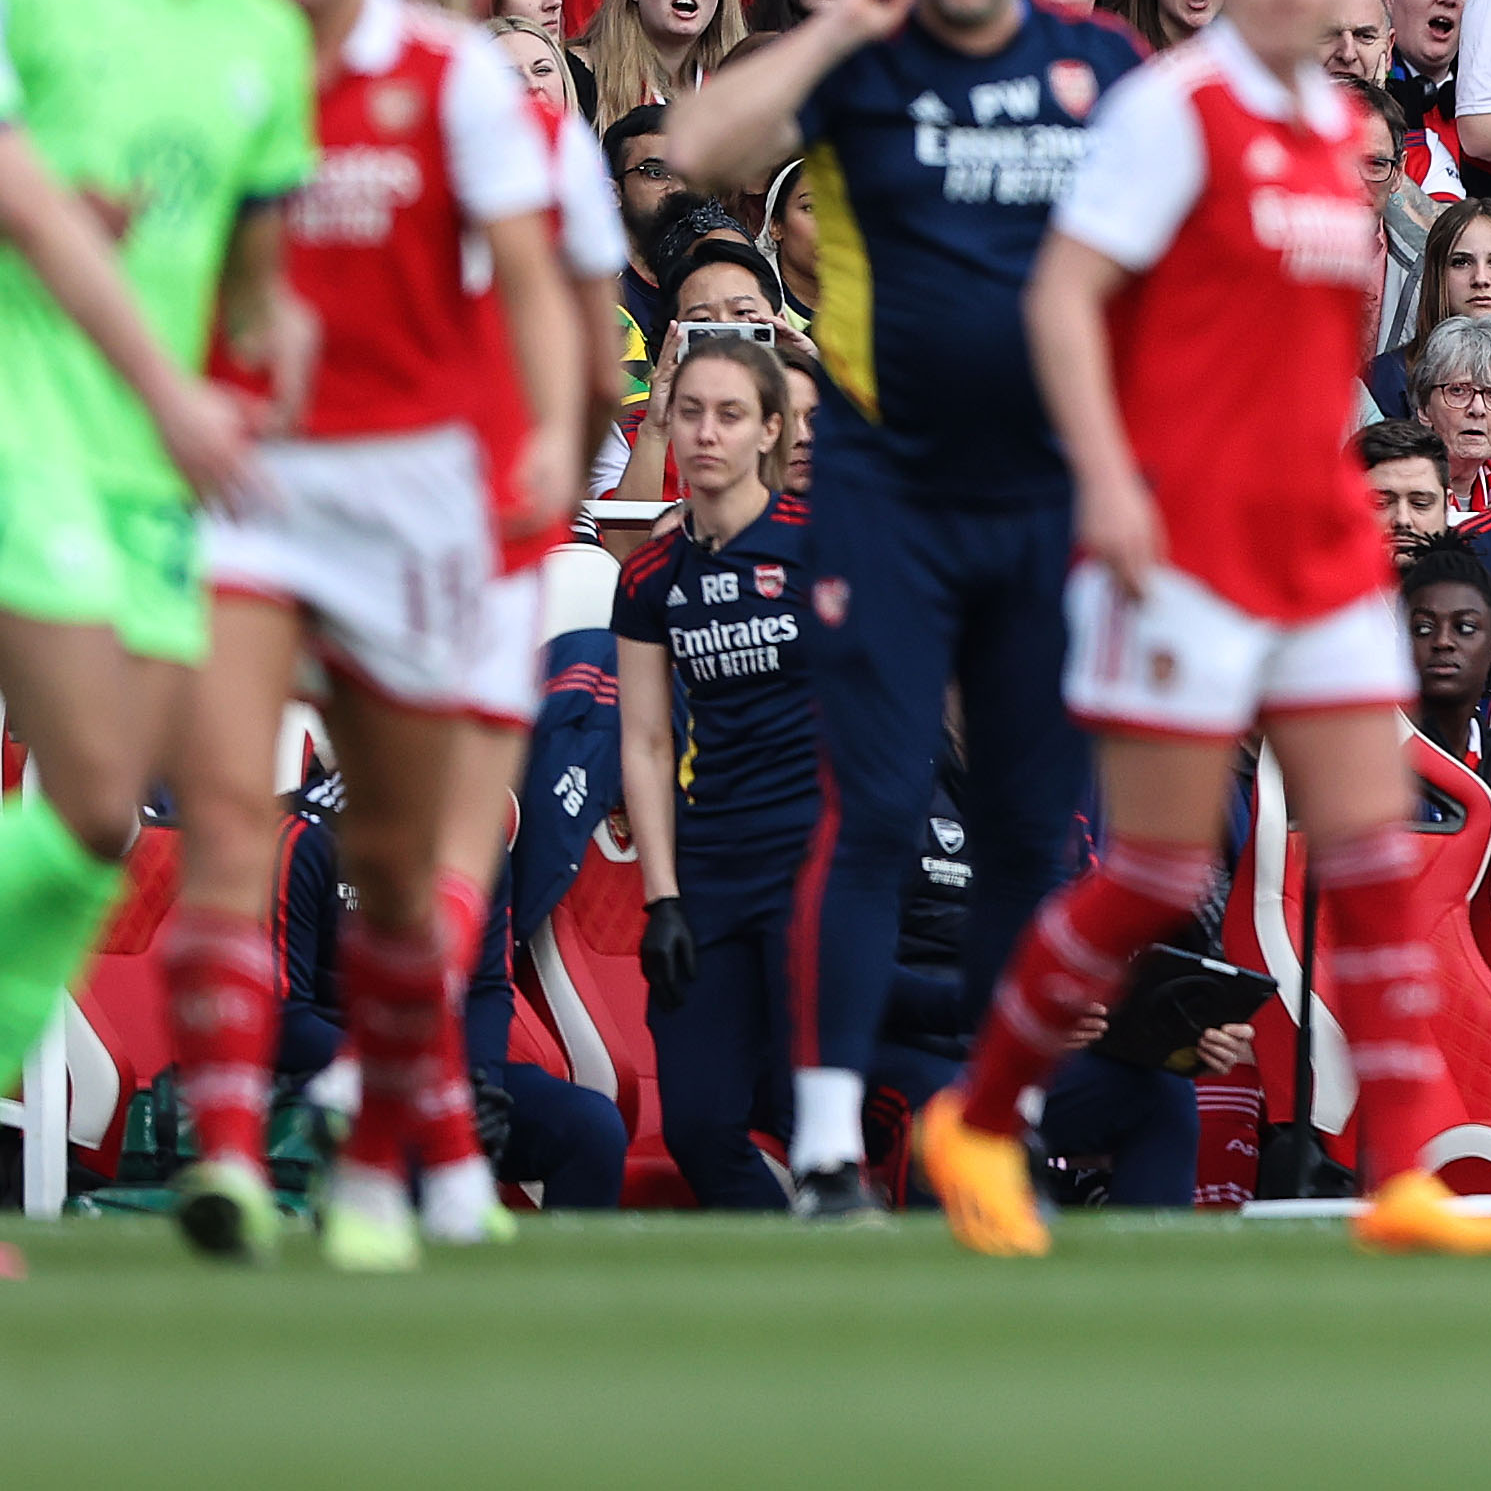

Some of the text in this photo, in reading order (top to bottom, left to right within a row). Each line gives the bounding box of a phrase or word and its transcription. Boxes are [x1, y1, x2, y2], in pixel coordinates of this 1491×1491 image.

[700, 572, 740, 606] RG
[670, 613, 799, 659] Emirates
[690, 644, 780, 682] FLY BETTER
